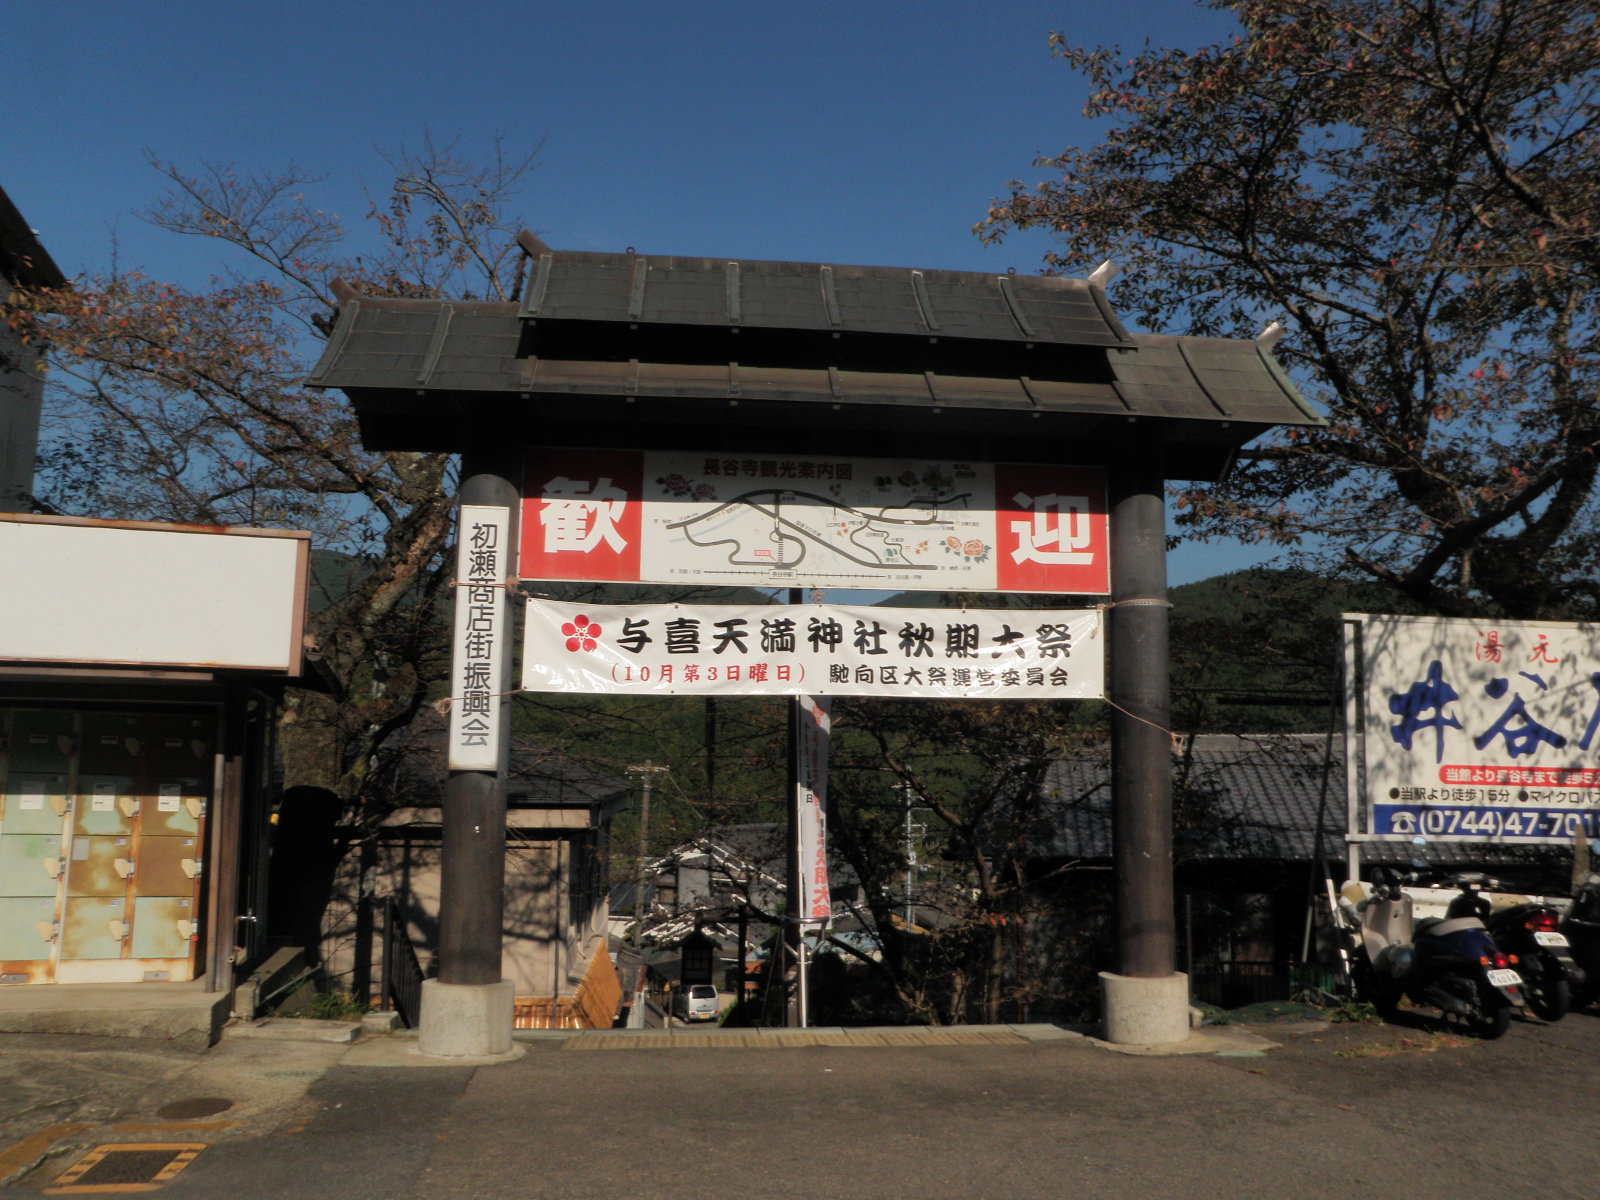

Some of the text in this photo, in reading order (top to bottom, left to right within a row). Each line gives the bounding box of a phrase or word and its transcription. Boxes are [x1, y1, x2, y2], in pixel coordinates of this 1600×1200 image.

[704, 459, 852, 480] 長谷寺観光案内図
[540, 476, 628, 554] 歓
[1010, 491, 1095, 566] 迎
[461, 522, 498, 747] 初瀬商店街振興会
[616, 616, 1072, 659] 与喜天満神社秋期大祭
[1419, 809, 1600, 836] (0744)47-701
